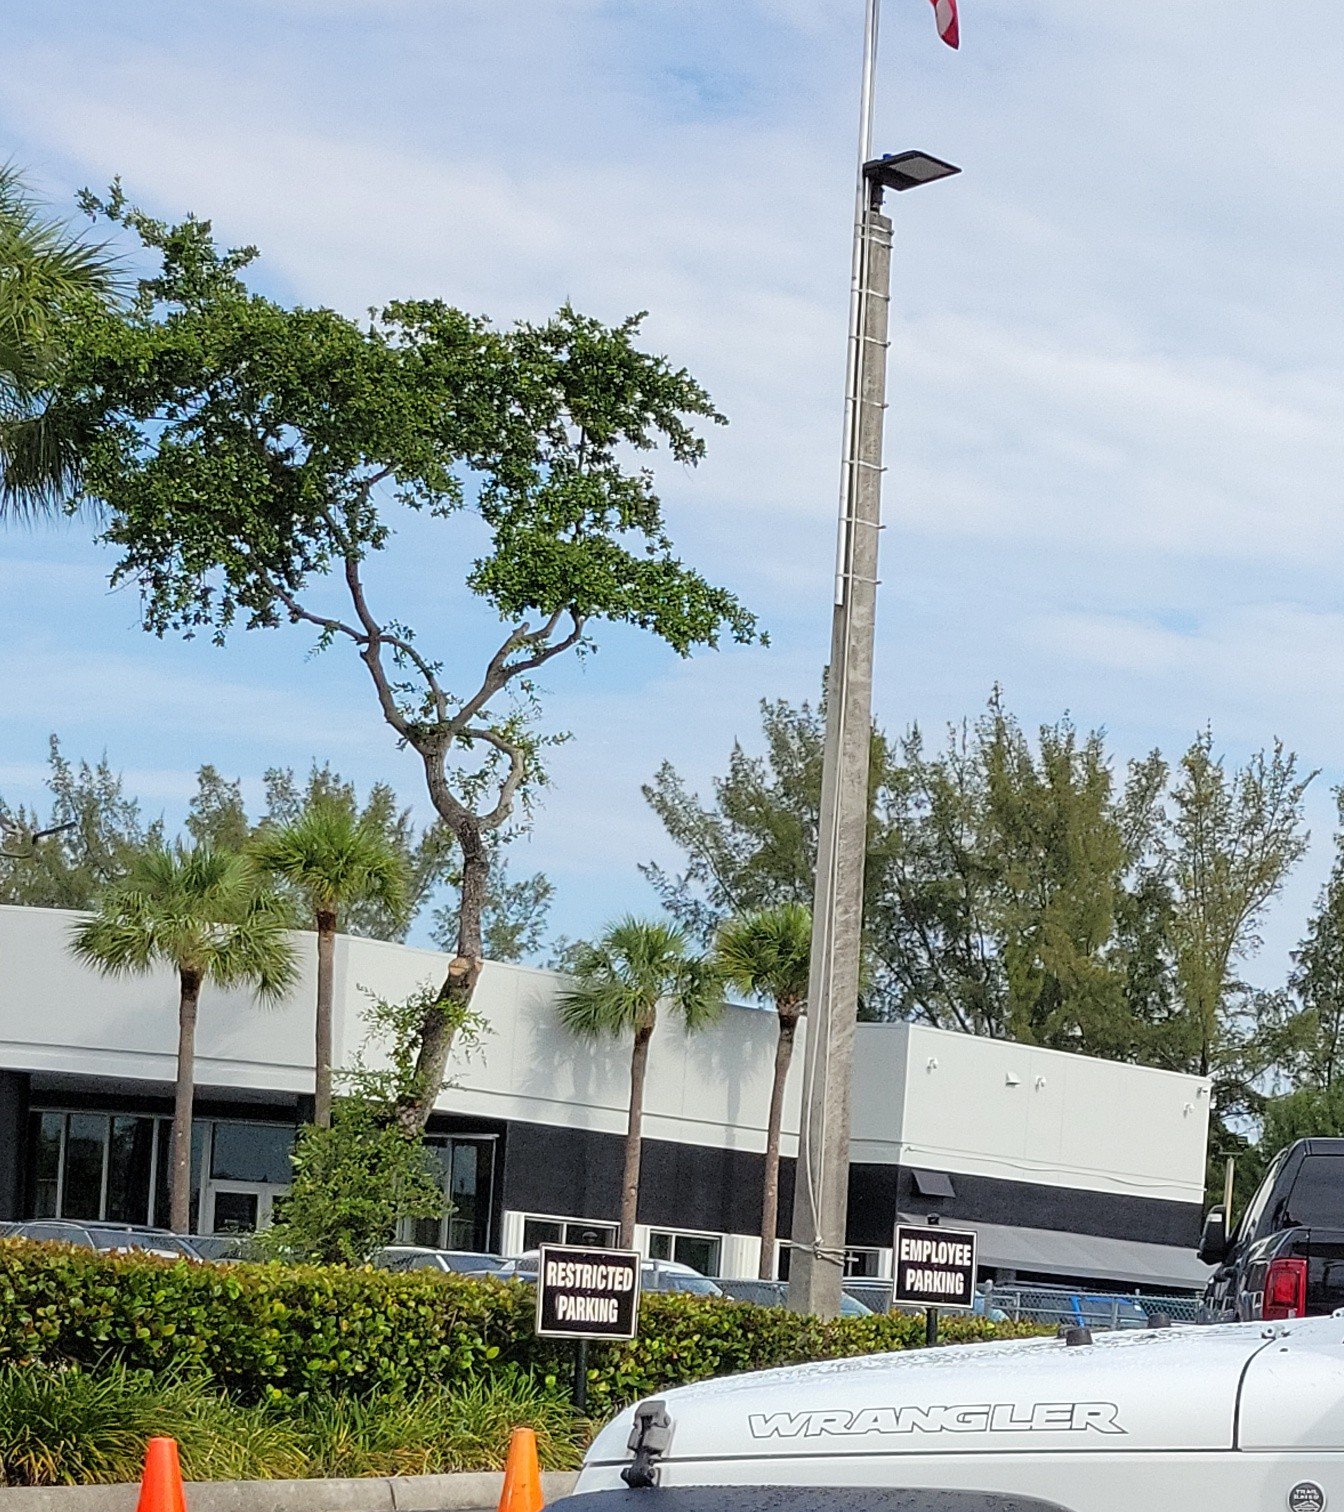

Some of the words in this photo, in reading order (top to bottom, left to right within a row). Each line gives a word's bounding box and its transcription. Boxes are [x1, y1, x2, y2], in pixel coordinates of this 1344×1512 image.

[900, 1238, 972, 1267] EMPLOYEE
[546, 1261, 634, 1292] RESTRICTED
[905, 1268, 965, 1296] PARKING
[556, 1295, 619, 1324] PARKING
[748, 1402, 1130, 1438] WRANGLER
